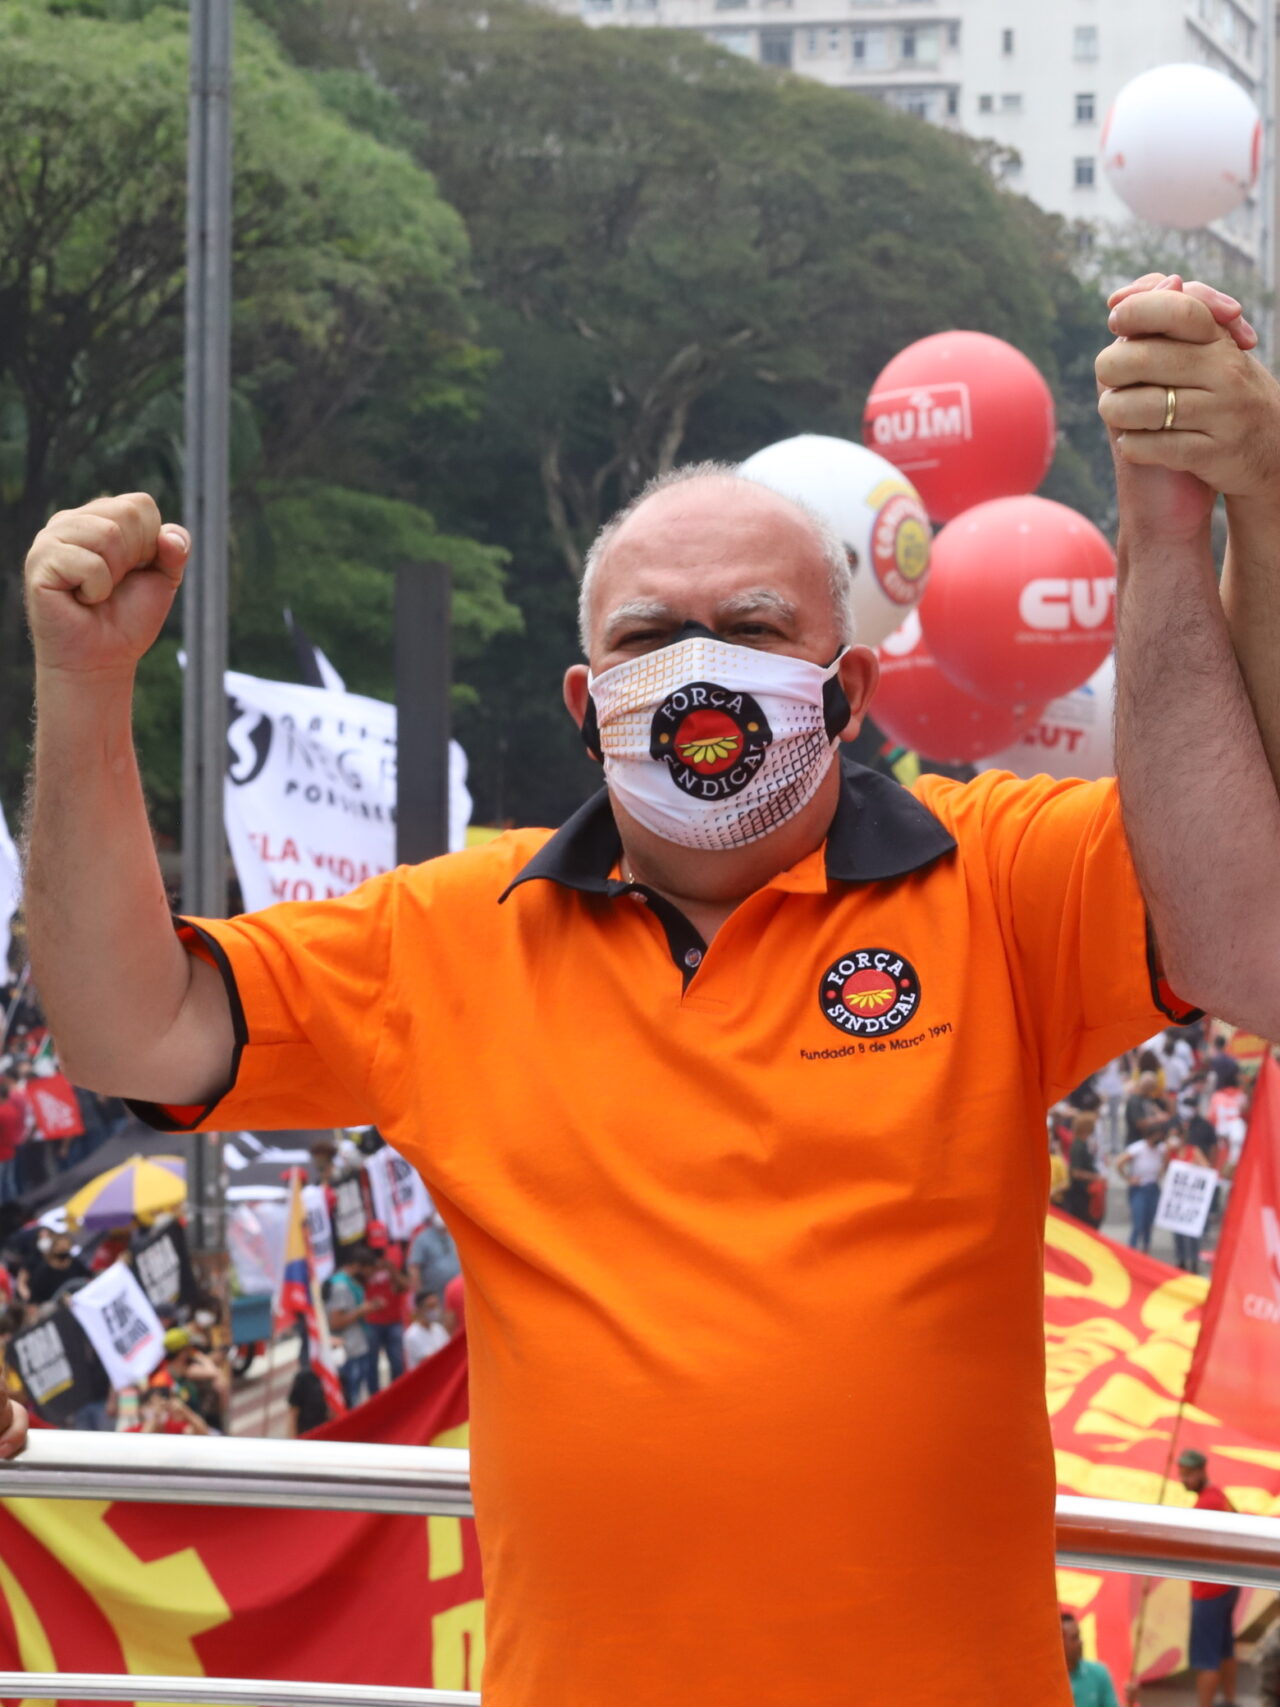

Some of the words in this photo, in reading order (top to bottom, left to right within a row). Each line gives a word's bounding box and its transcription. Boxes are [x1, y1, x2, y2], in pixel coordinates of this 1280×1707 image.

[661, 687, 743, 721] FORÇA
[663, 741, 768, 797] SINDICAL
[827, 953, 904, 985] FORÇA
[827, 992, 916, 1032] SINDICAL
[800, 1042, 856, 1060] Fundada
[858, 1042, 865, 1053] 8
[869, 1040, 886, 1052] de
[889, 1033, 925, 1050] Março
[928, 1022, 953, 1038] 1991
